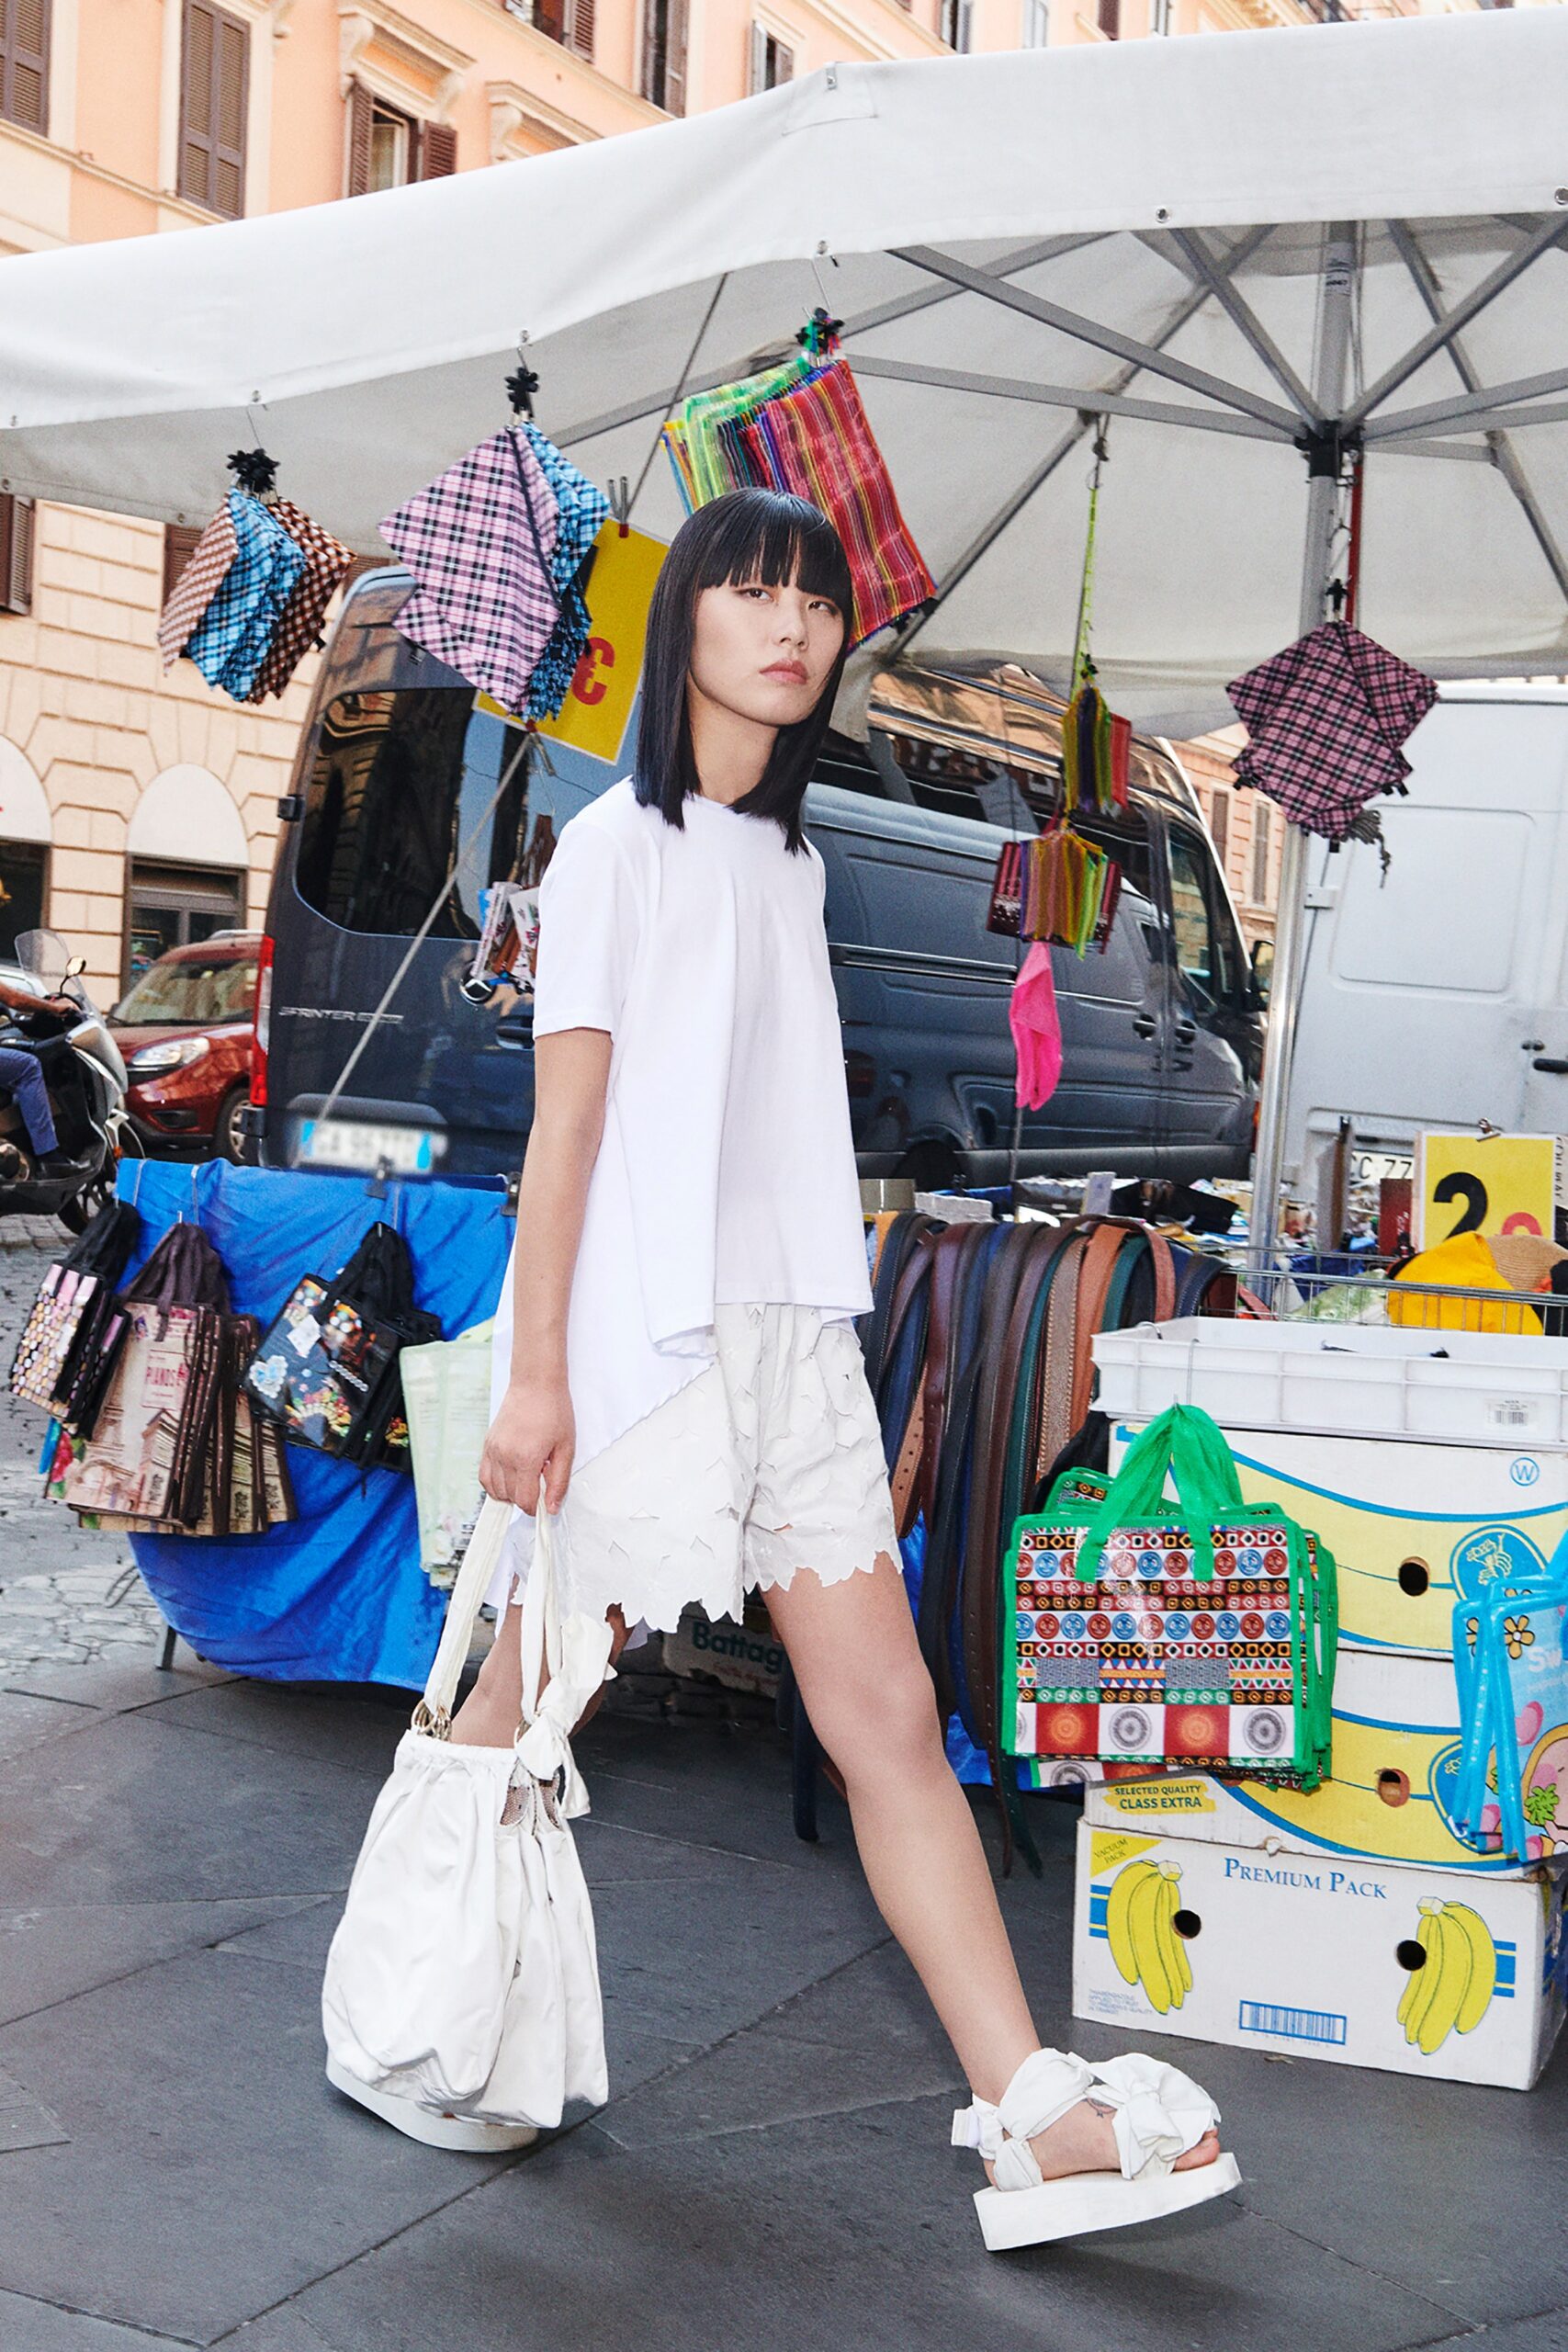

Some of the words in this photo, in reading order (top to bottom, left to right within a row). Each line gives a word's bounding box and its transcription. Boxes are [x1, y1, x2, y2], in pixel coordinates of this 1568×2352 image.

[1433, 1171, 1488, 1242] 2
[1114, 1786, 1159, 1795] SELECTED
[1161, 1785, 1201, 1795] QUALITY
[1119, 1798, 1158, 1809] CLASS
[1160, 1796, 1202, 1809] EXTRA
[1093, 1838, 1129, 1859] VACUUM
[1104, 1849, 1127, 1865] PACK
